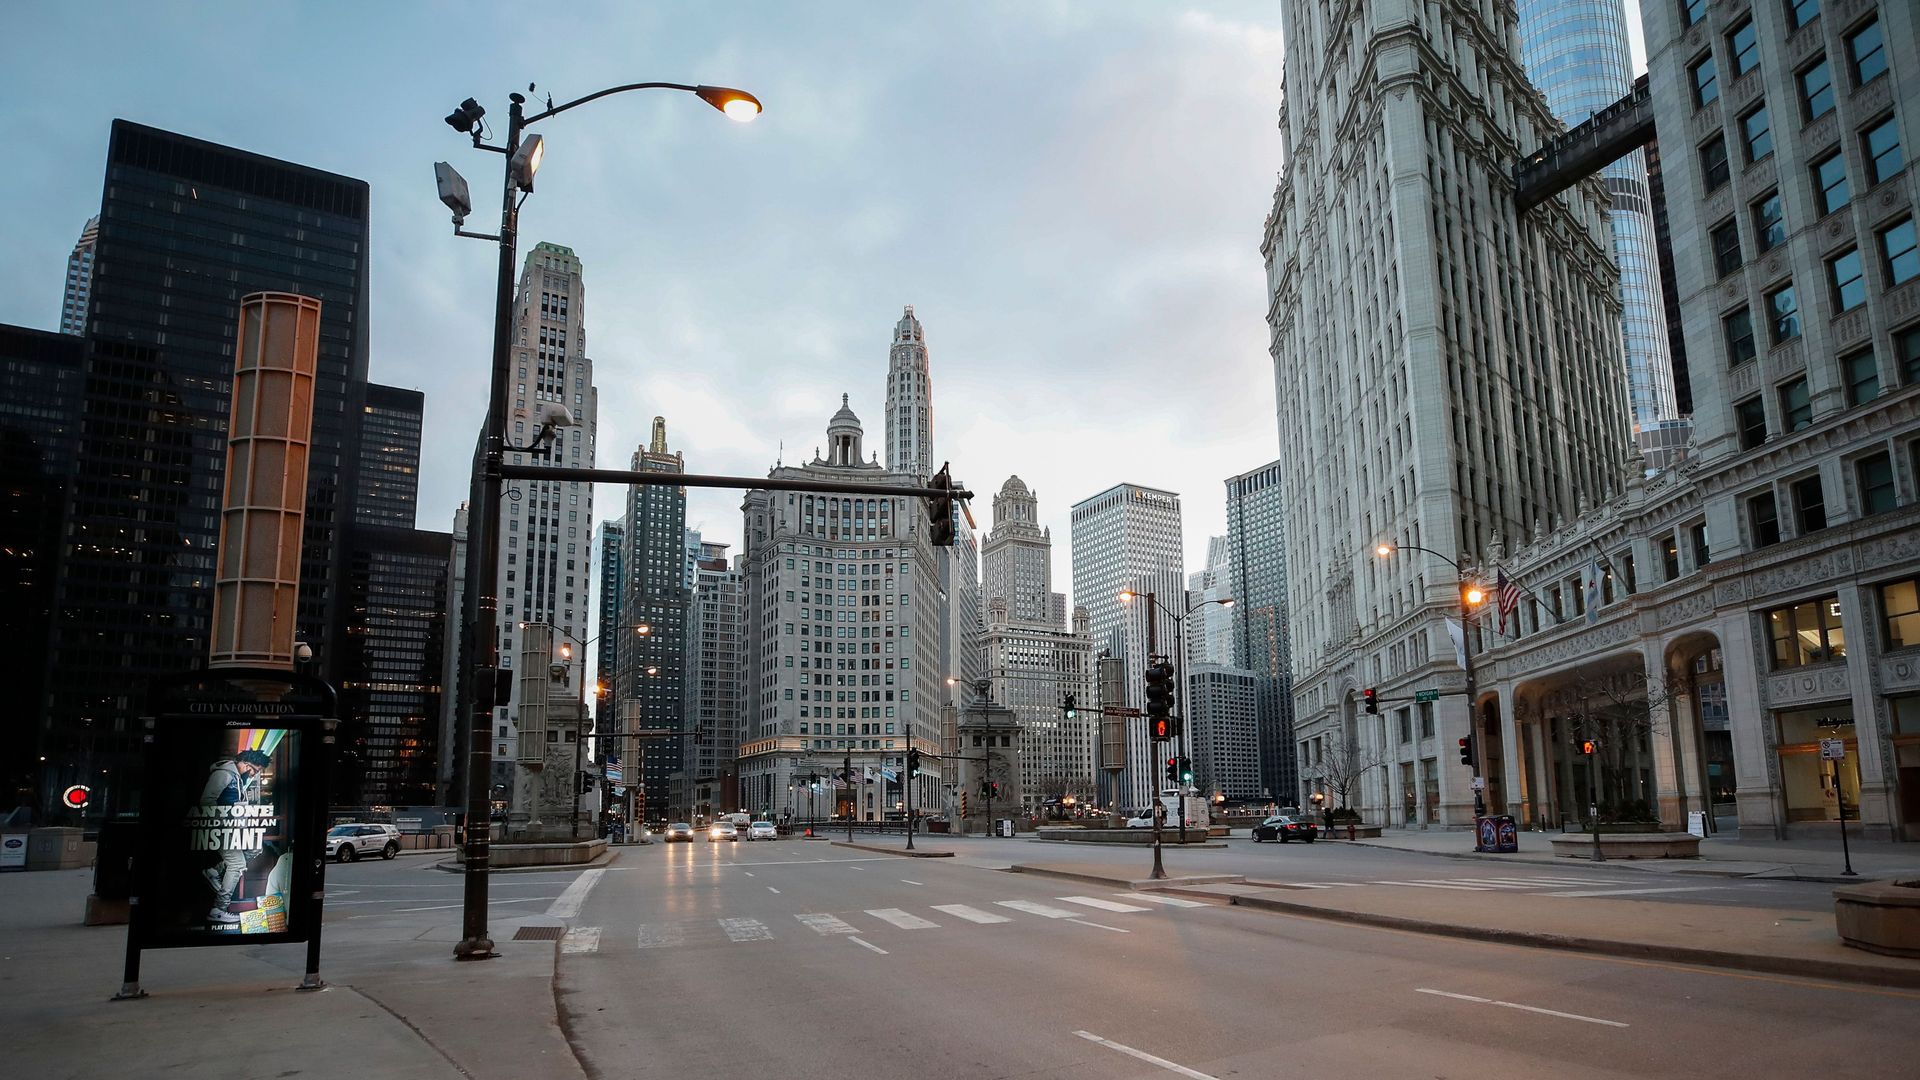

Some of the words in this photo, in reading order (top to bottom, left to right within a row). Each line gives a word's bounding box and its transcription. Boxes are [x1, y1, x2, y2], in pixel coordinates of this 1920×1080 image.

[1142, 491, 1172, 503] KEMPER
[189, 703, 217, 713] CITY
[219, 703, 296, 714] INFORMATION
[187, 804, 275, 818] ANYONE
[222, 818, 246, 828] WIN
[247, 818, 259, 828] IN
[260, 818, 277, 827] AN
[190, 828, 267, 851] INSTANT
